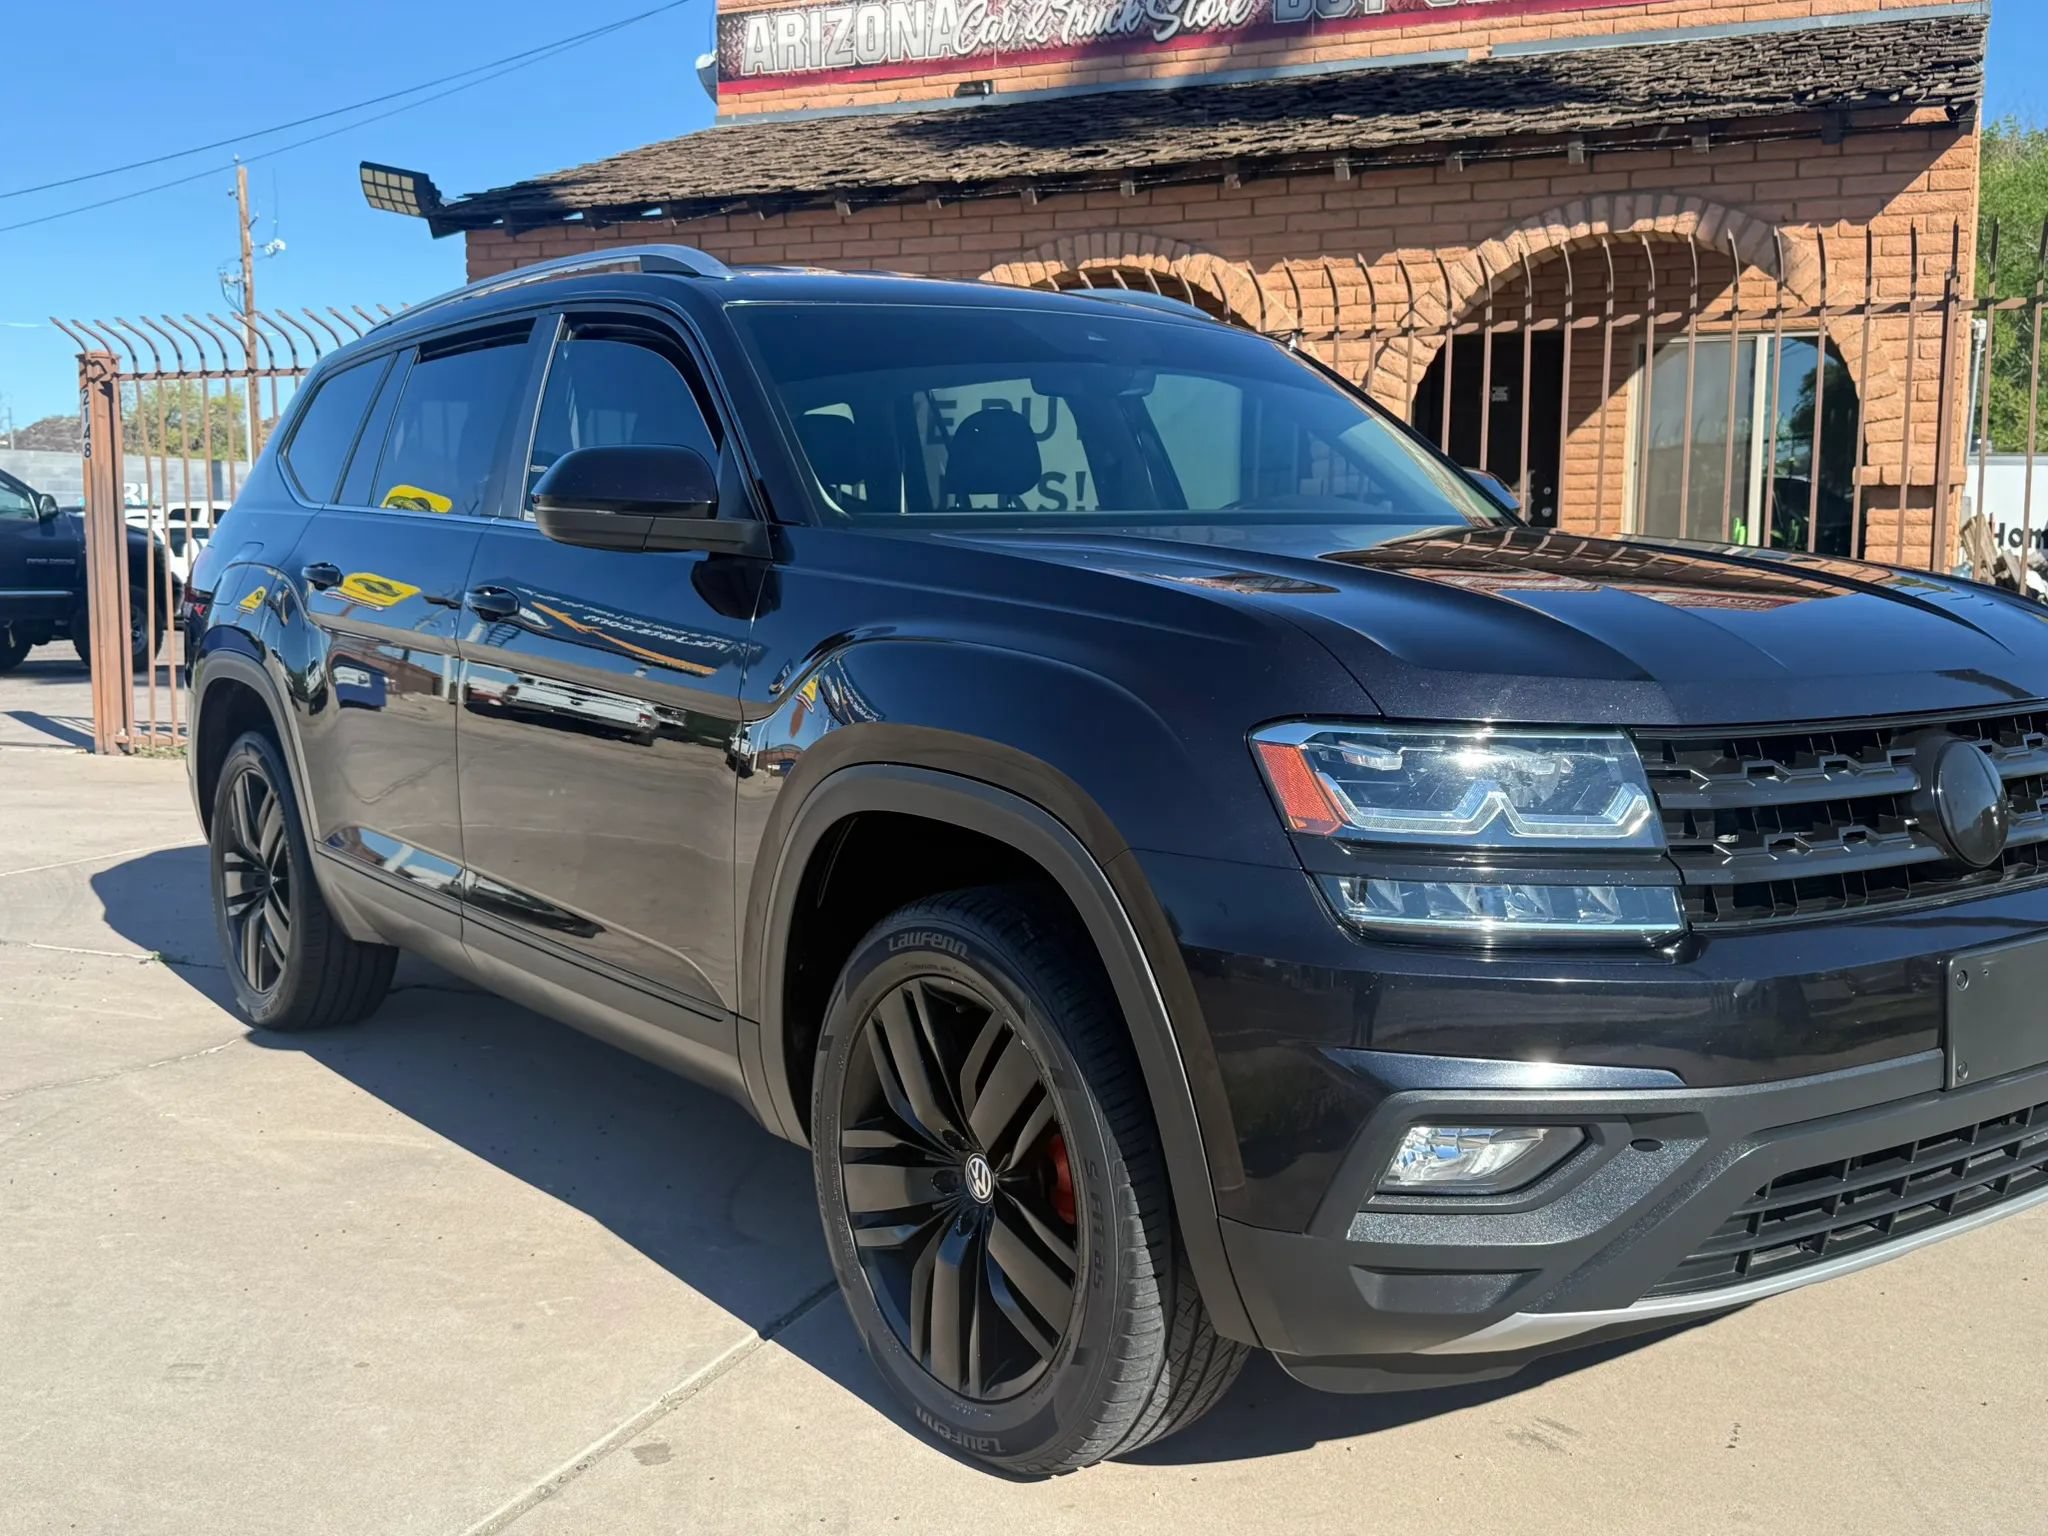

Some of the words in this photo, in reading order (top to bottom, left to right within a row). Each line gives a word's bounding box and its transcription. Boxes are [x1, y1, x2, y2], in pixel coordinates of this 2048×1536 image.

[741, 0, 960, 75] ARIZONA
[954, 1, 1017, 54] Car
[1053, 0, 1143, 44] Truck
[83, 388, 92, 458] 2148
